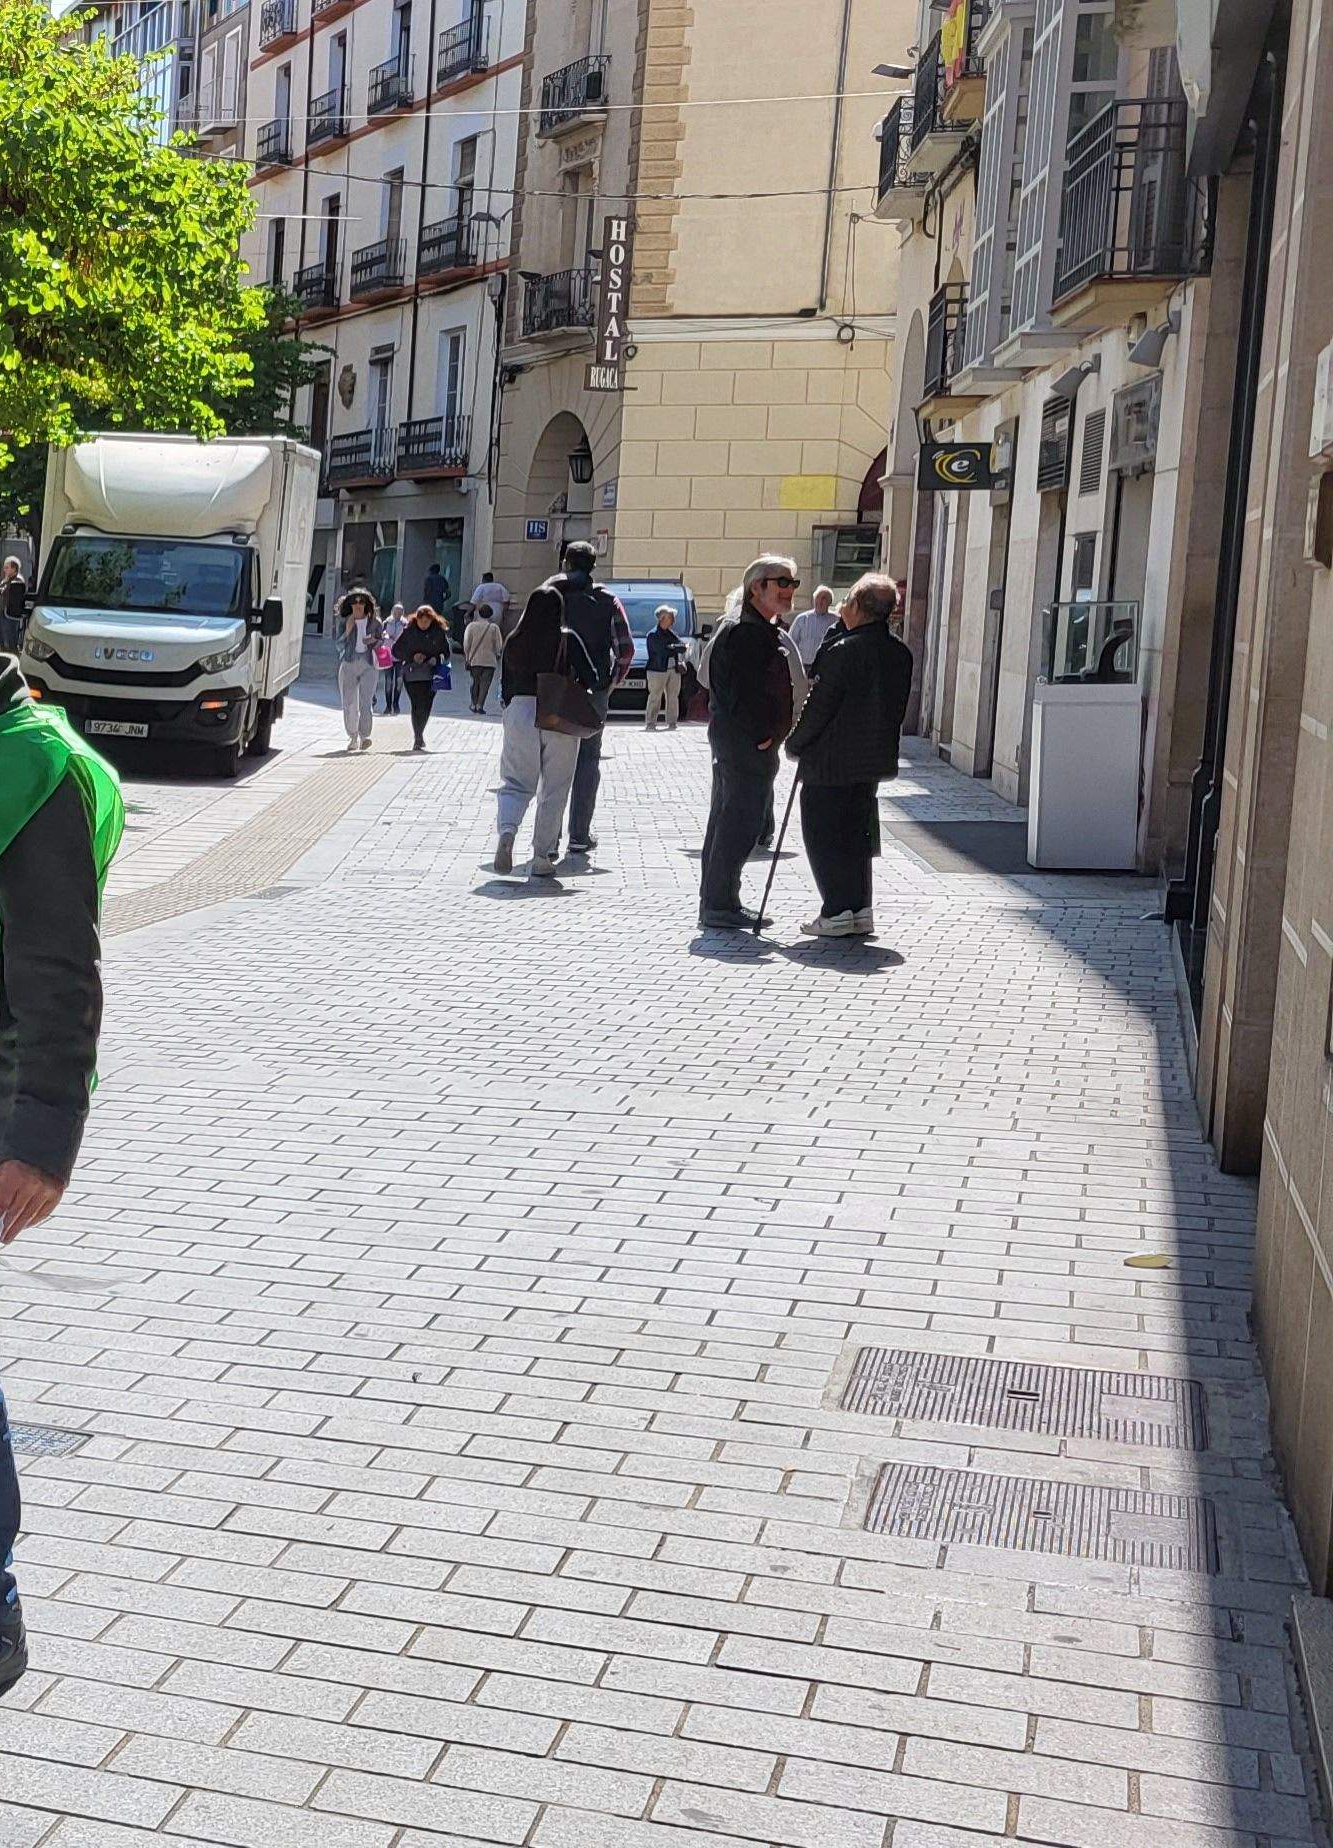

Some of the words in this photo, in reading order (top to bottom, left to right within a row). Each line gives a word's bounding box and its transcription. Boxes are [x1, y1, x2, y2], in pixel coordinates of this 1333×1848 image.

[604, 219, 628, 361] HOSTAL
[529, 521, 546, 533] HS
[94, 647, 154, 661] IVECO
